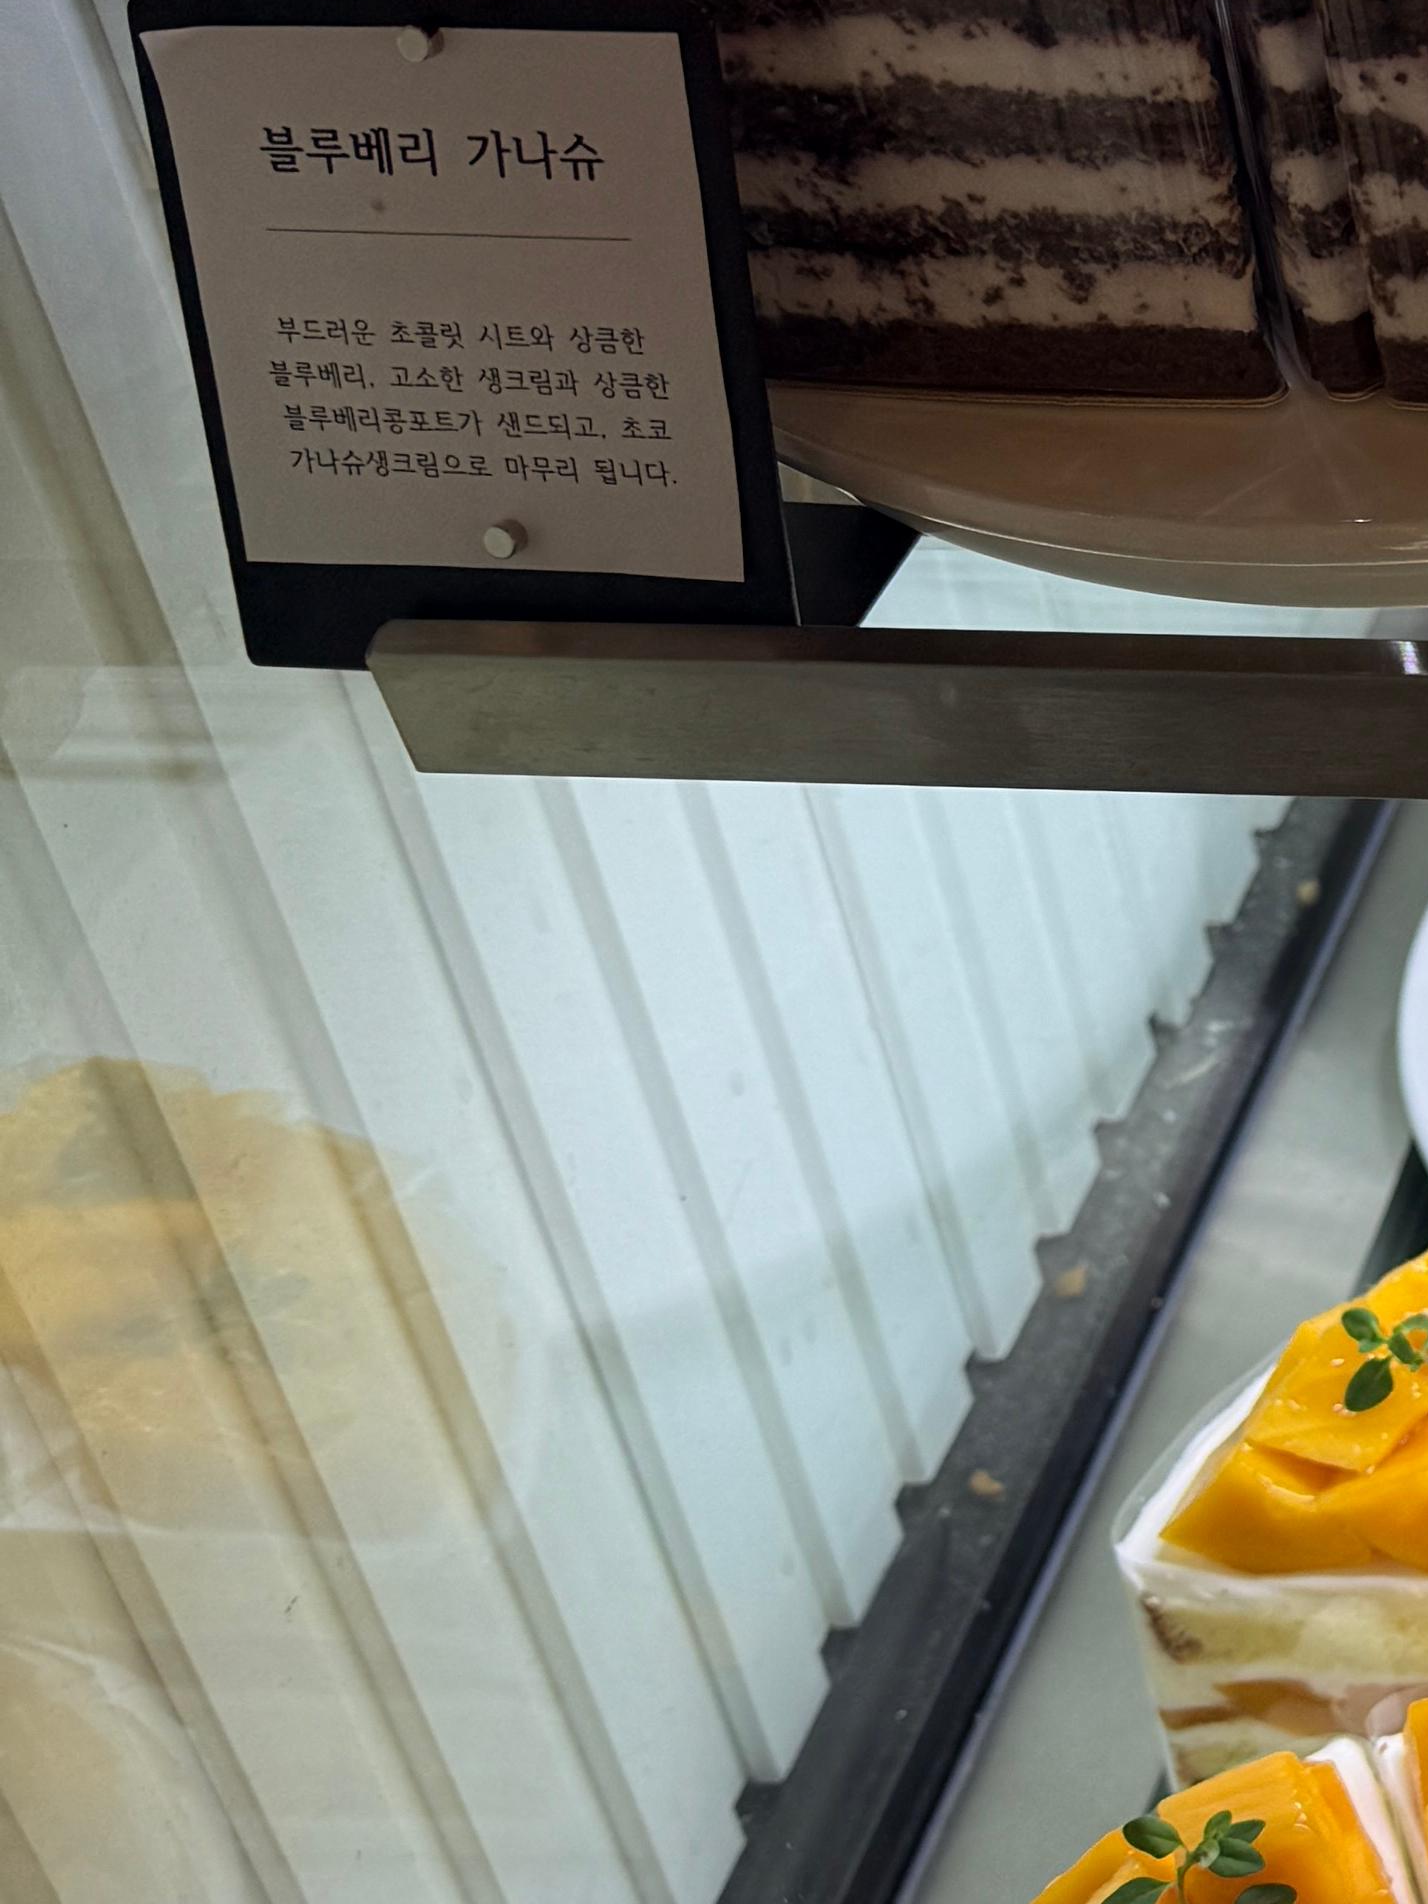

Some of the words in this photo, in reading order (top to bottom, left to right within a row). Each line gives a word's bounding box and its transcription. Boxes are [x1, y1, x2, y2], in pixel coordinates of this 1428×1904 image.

[259, 125, 438, 177] 블루베리
[466, 129, 605, 182] 가나슈
[276, 316, 376, 347] 부드러운
[390, 320, 465, 350] 초콜릿
[478, 322, 555, 353] 시트와
[569, 325, 645, 356] 상큼한
[389, 365, 464, 393] 고소한
[478, 366, 579, 397] 생크림과
[593, 370, 670, 401] 상큼한
[283, 404, 483, 438] 블루베리콩포트가
[621, 416, 673, 441] 초코
[289, 447, 493, 479] 가나슈생크림으로
[503, 454, 579, 484] 마무리
[593, 458, 678, 488] 됩니다.
